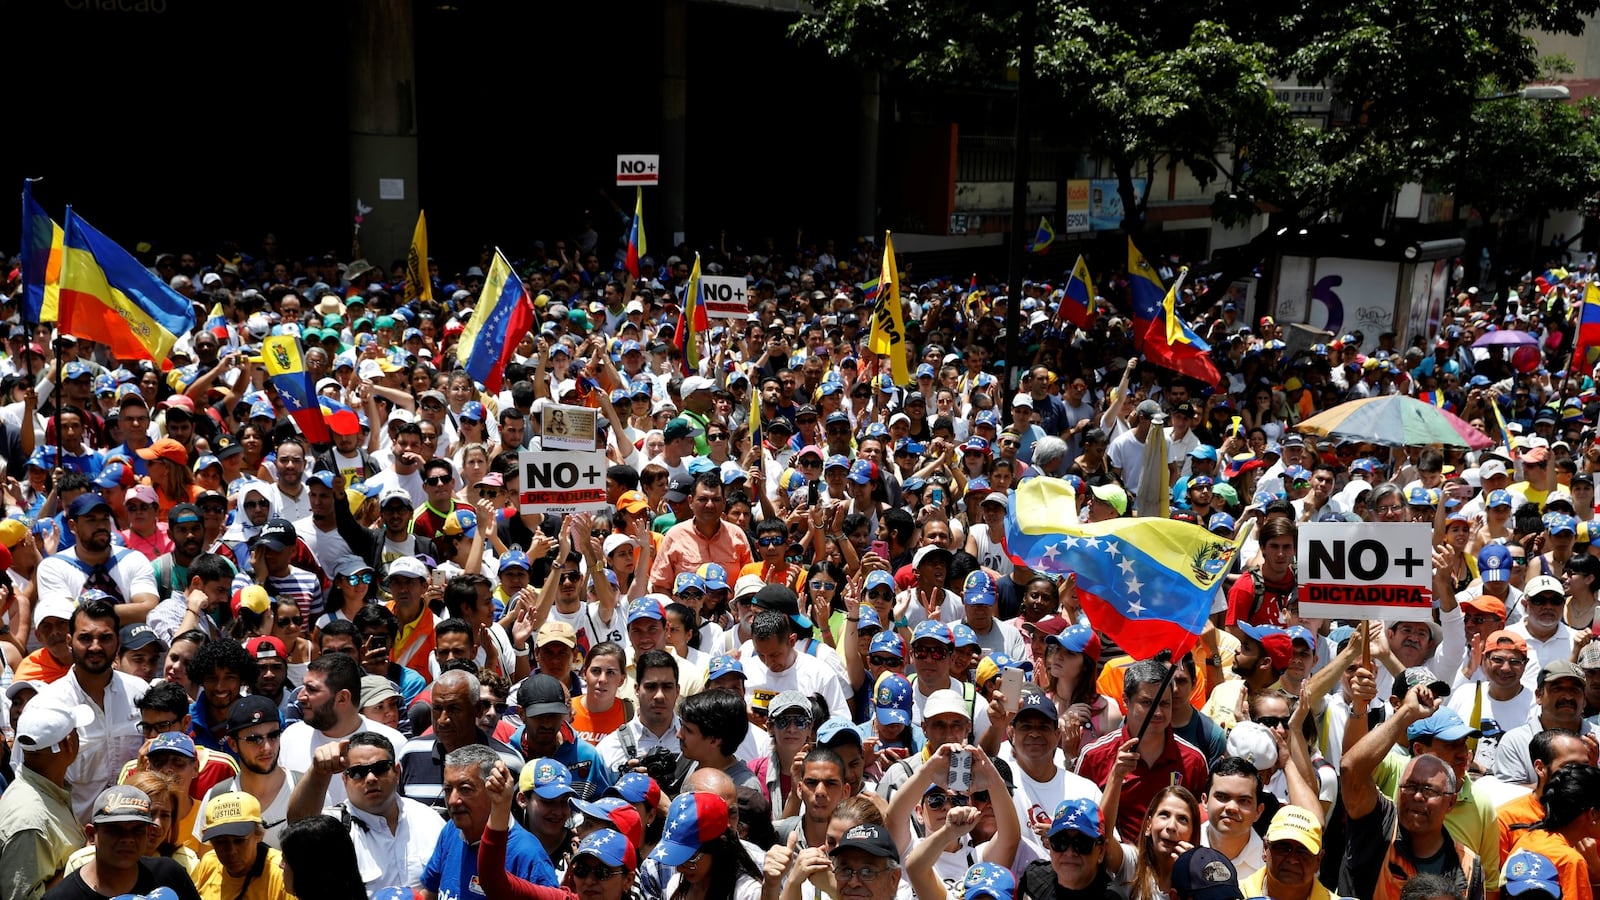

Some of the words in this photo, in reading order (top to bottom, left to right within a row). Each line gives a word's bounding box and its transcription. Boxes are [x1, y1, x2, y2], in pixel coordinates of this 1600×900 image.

[1294, 91, 1324, 102] PERU
[620, 160, 656, 173] NO+
[1068, 214, 1087, 227] EPSON
[704, 283, 744, 301] NO+
[527, 462, 601, 489] NO+
[528, 490, 600, 502] DICTADURA
[1309, 539, 1424, 581] NO+
[1309, 586, 1423, 603] DICTADURA
[212, 808, 241, 819] JUSTICIA
